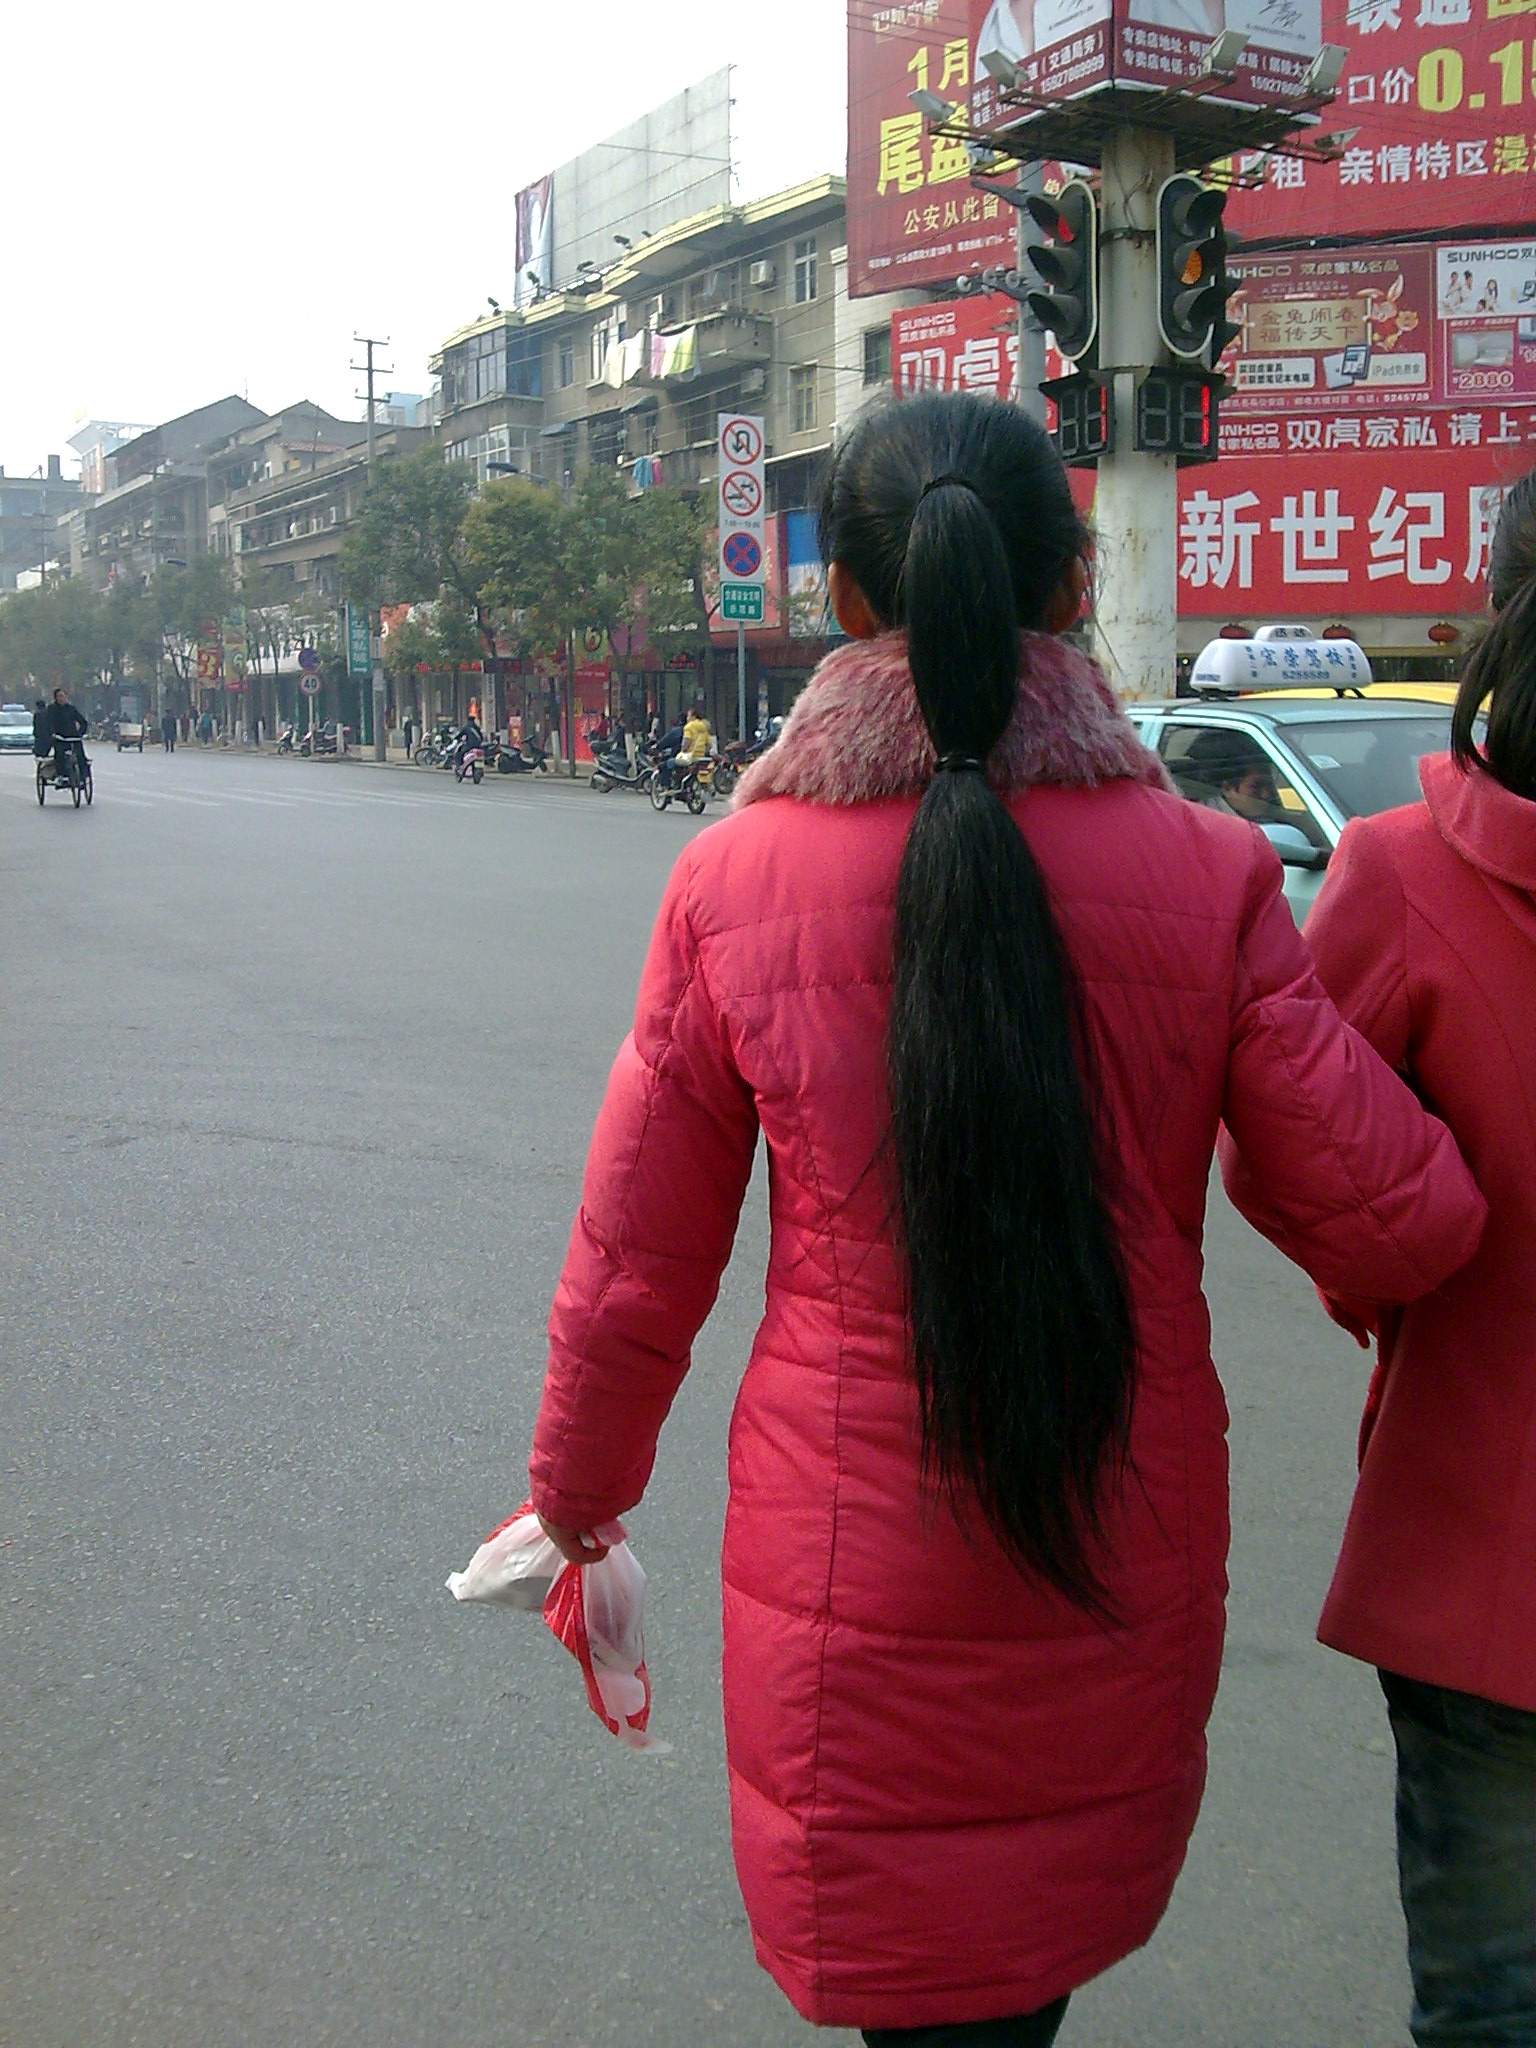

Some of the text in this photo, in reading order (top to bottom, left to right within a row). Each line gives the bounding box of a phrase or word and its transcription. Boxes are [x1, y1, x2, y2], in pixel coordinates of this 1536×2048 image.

[1338, 133, 1536, 186] 亲情特区漫
[904, 193, 1014, 235] 公安从此留
[1447, 249, 1518, 263] SUNHOO
[1226, 264, 1292, 279] NHOO
[899, 312, 956, 331] SUNHOO
[1219, 423, 1279, 437] NHOO
[1286, 411, 1536, 449] 双虎家私 请上
